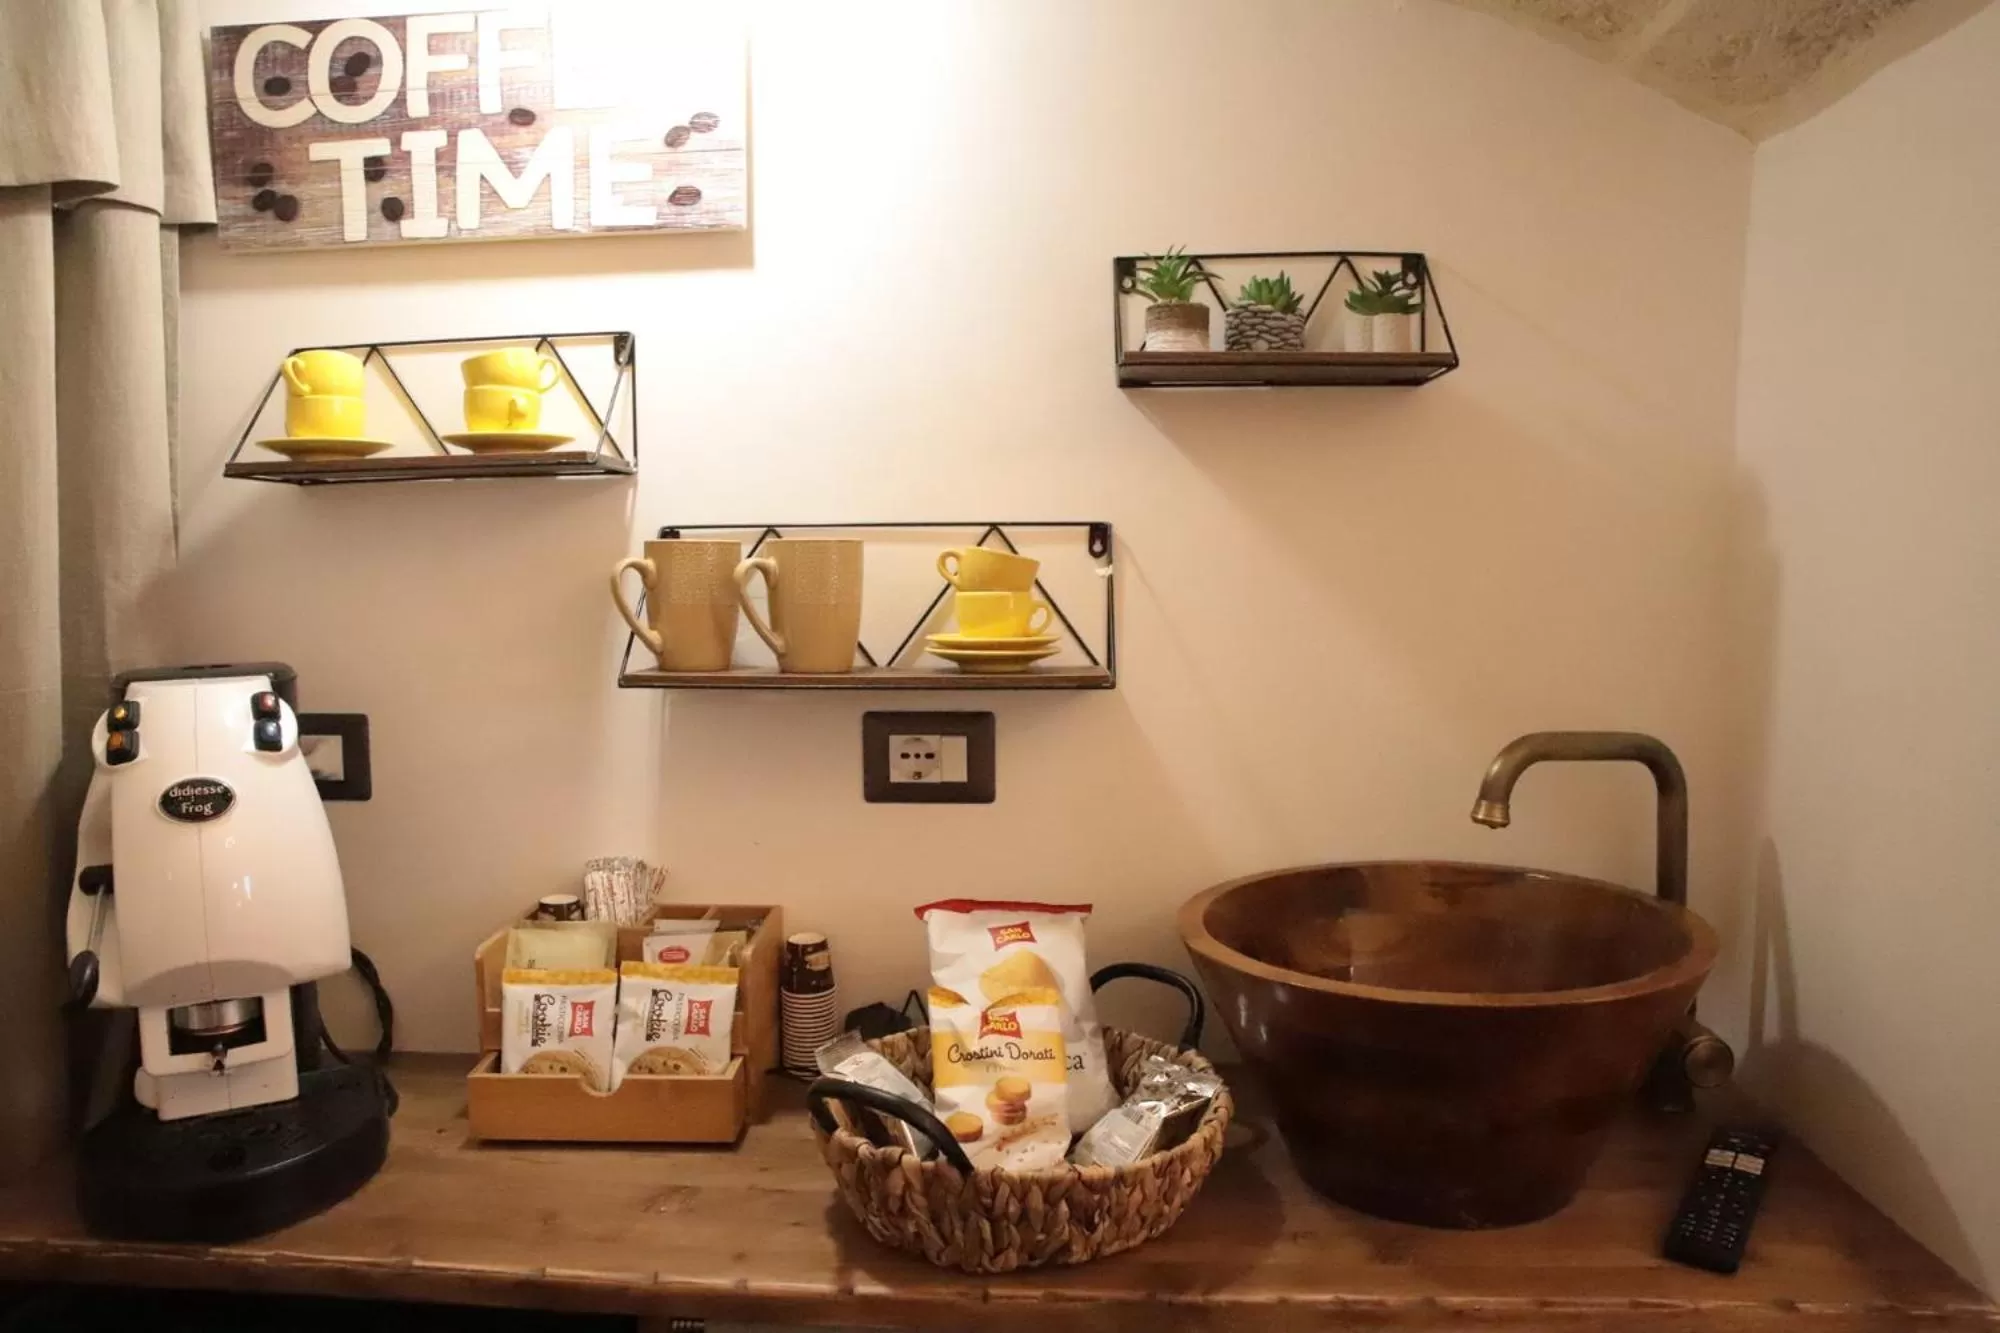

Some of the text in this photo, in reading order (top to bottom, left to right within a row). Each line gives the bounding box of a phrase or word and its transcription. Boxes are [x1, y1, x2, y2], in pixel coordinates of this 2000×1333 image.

[233, 12, 546, 128] COFF
[308, 126, 658, 242] TIME
[169, 785, 225, 797] didiesse
[181, 801, 214, 815] Frog
[995, 931, 1030, 944] CARLO
[1000, 927, 1022, 936] SAN
[536, 993, 555, 1047] Cookie
[574, 1004, 584, 1034] CARLO
[582, 1008, 590, 1029] SAN
[650, 989, 673, 1042] Cookie
[690, 1002, 700, 1033] CARLO
[948, 1042, 1056, 1063] Crostini Dorati
